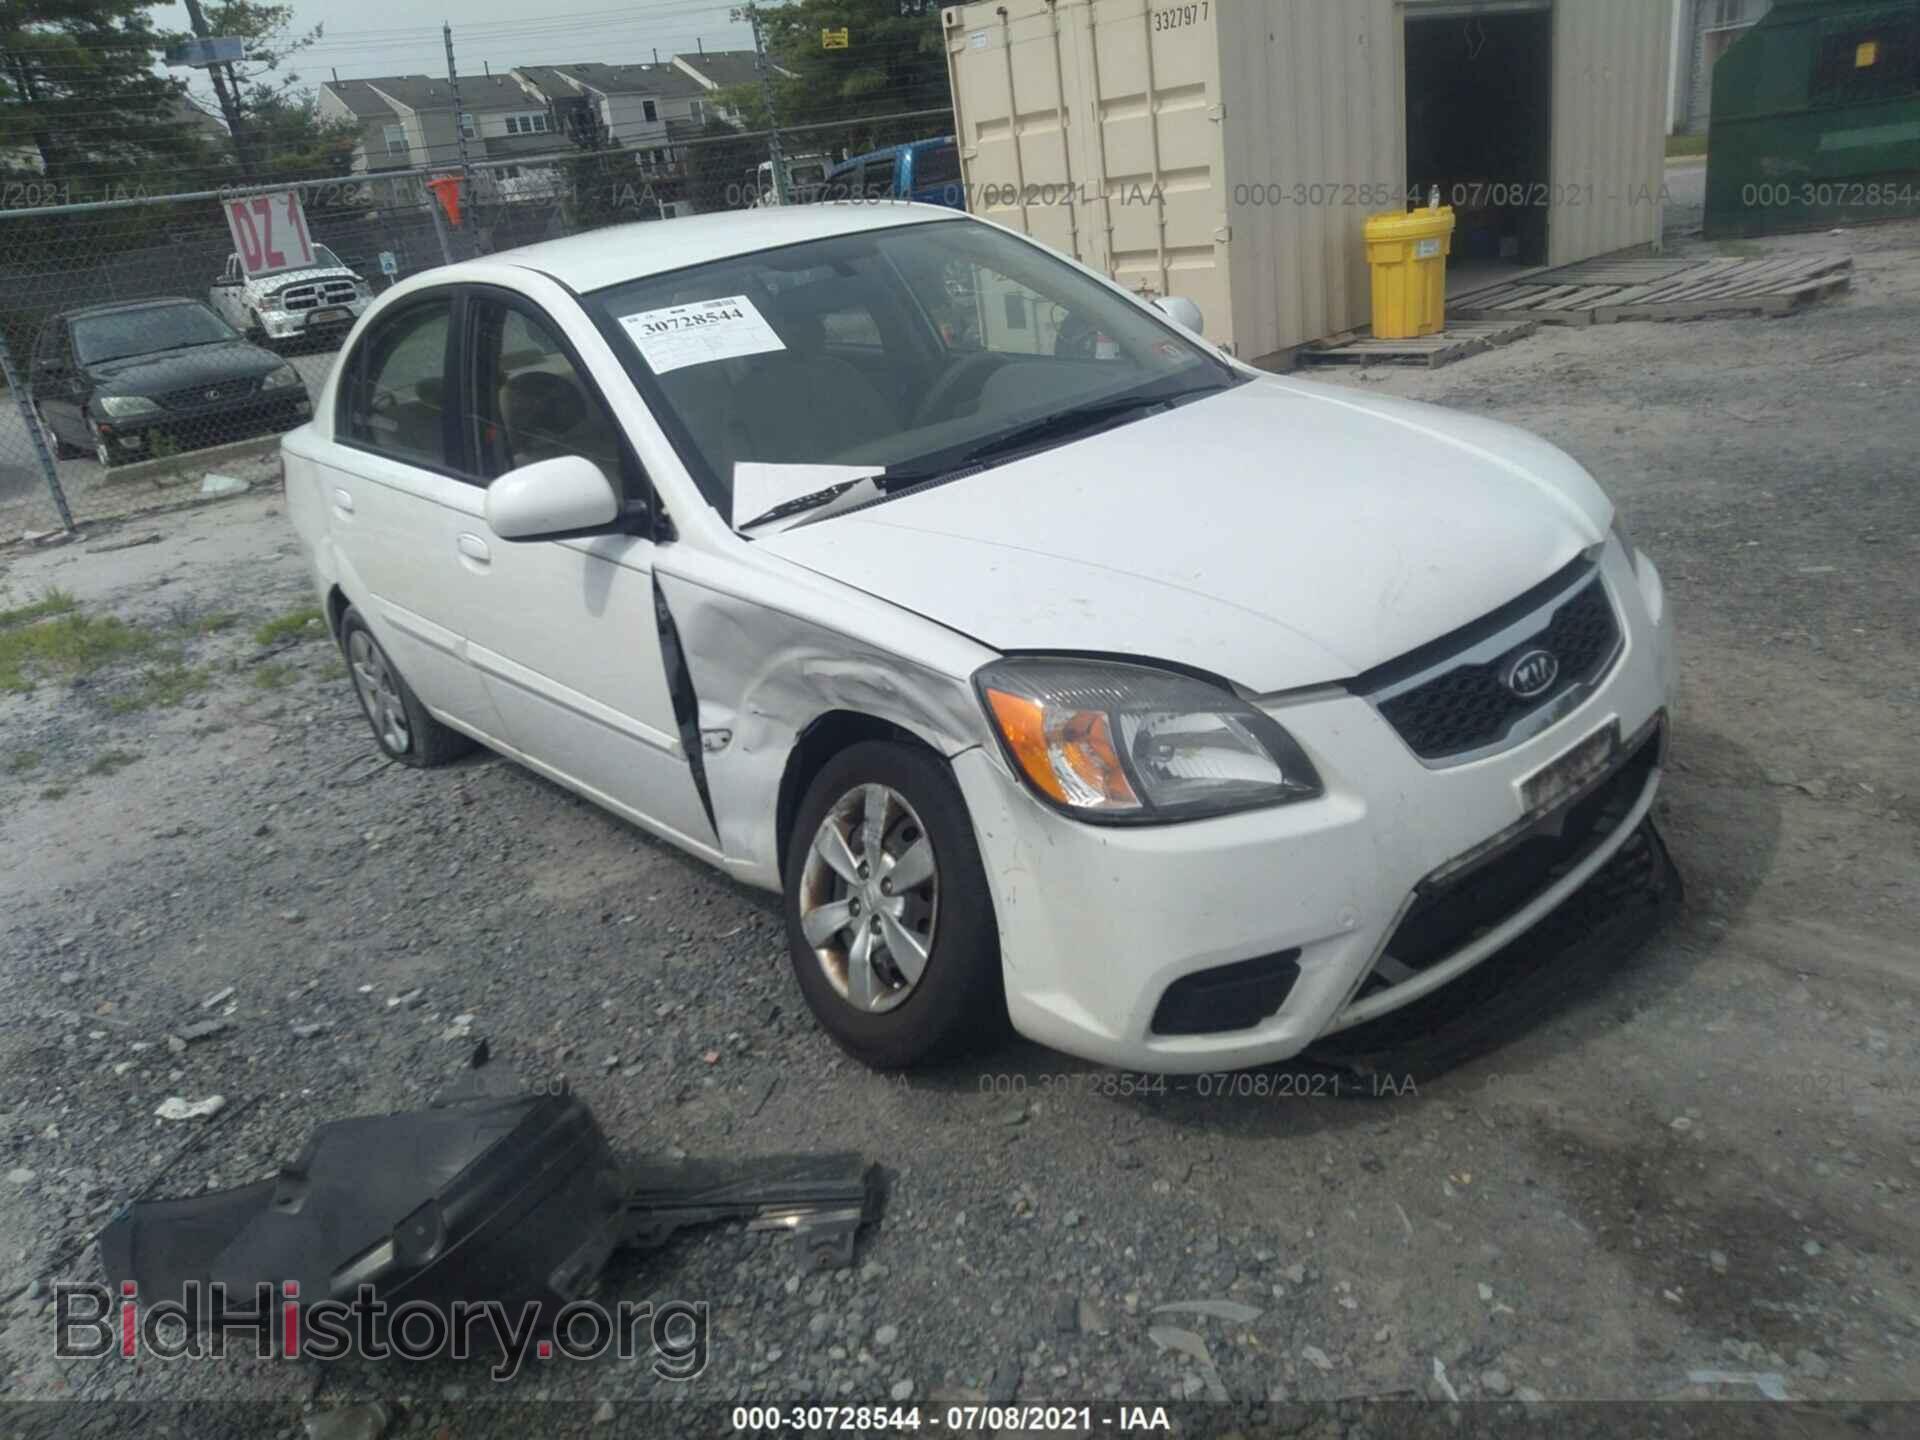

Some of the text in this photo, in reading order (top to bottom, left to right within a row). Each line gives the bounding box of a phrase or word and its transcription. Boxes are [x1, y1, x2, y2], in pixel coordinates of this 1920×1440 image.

[1154, 1, 1209, 32] 332797 7
[641, 307, 744, 336] 30728544
[1516, 657, 1553, 691] KIA
